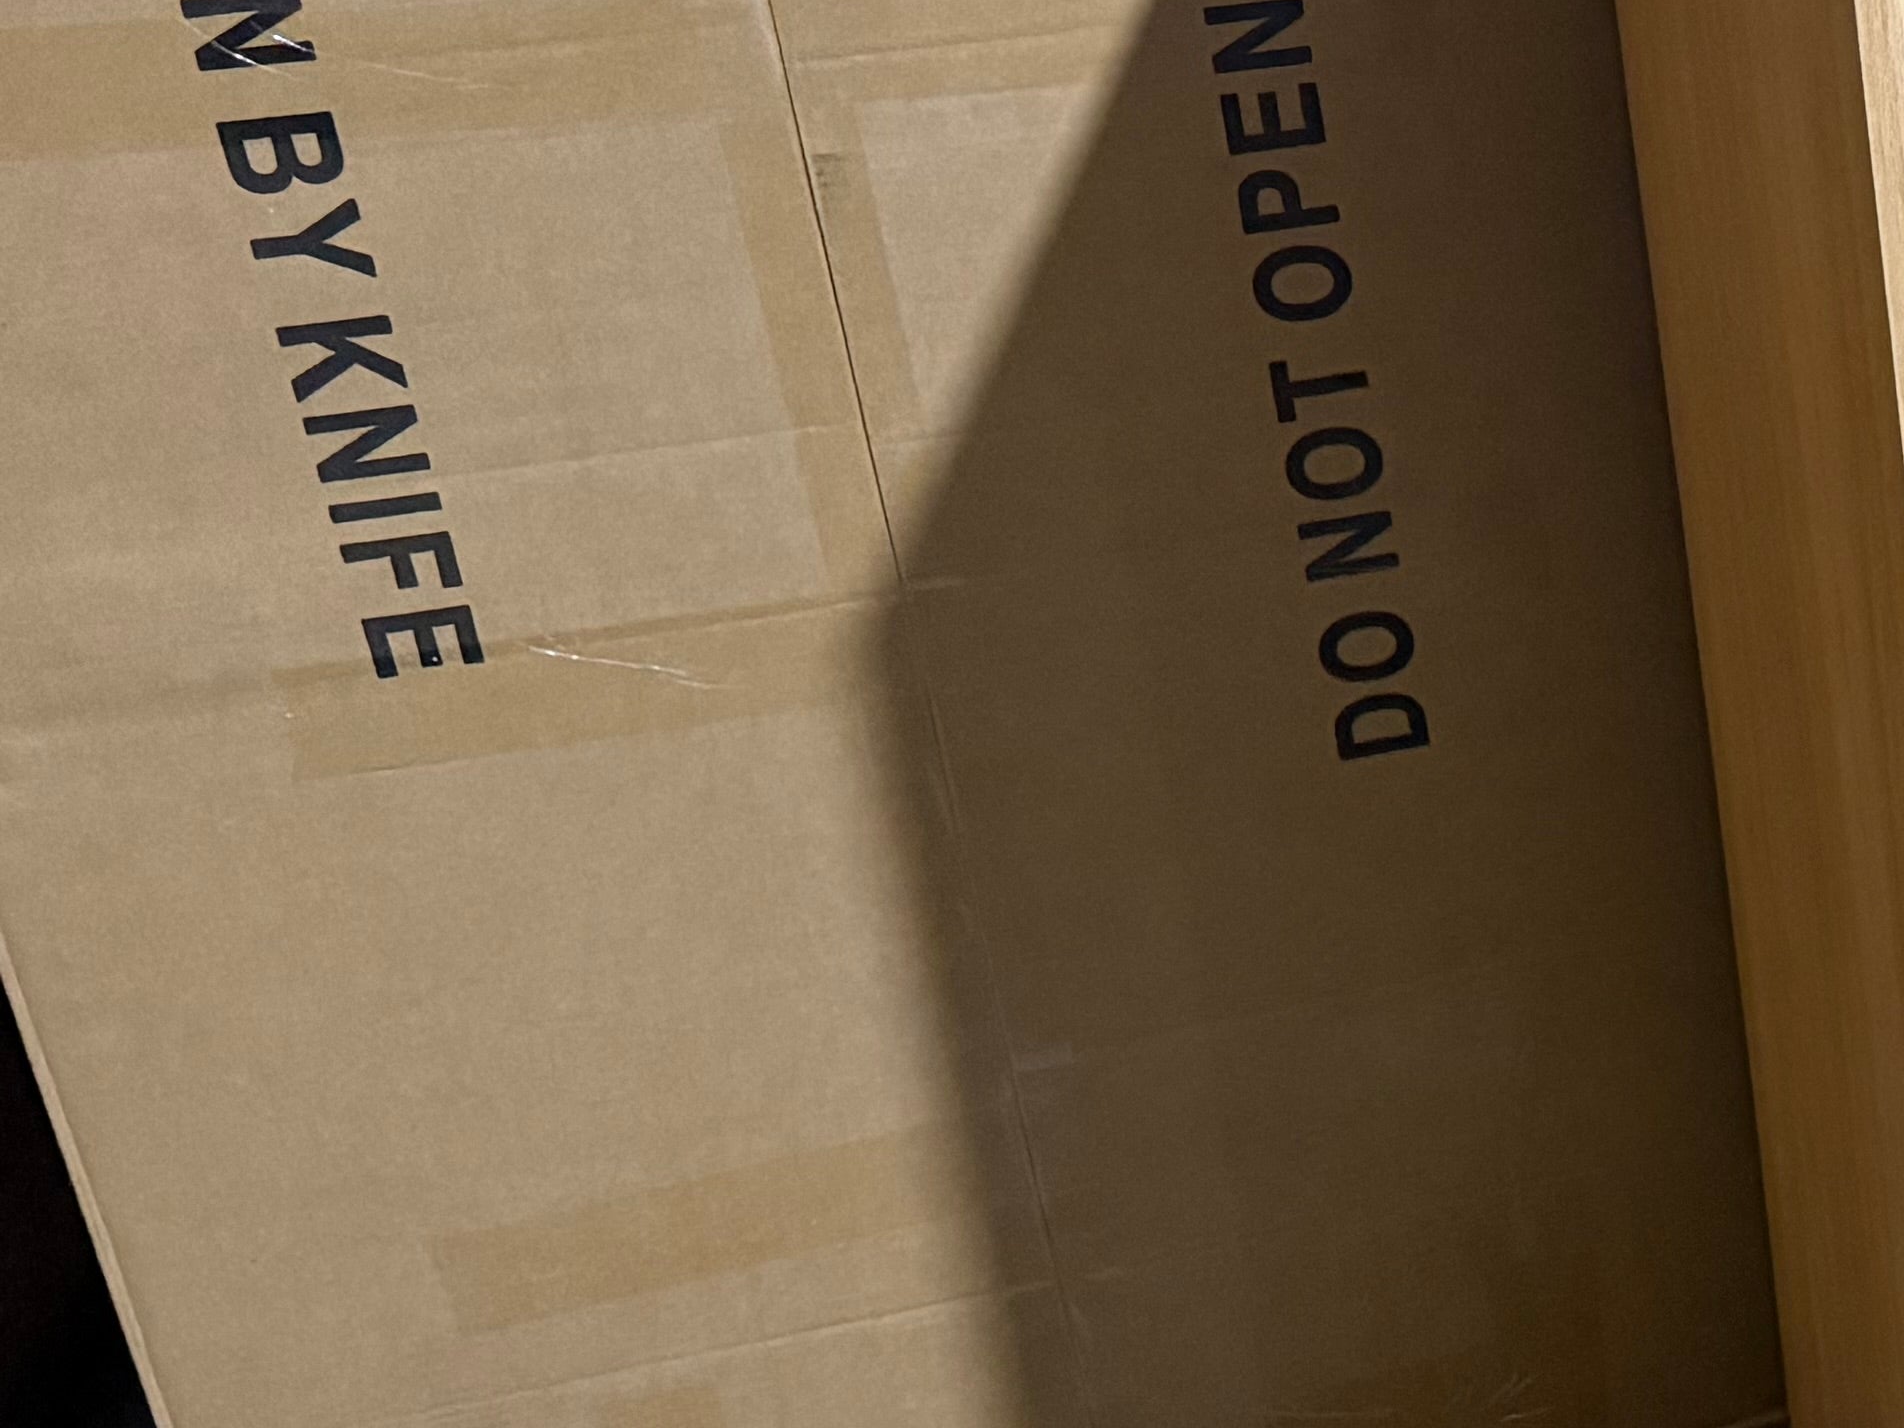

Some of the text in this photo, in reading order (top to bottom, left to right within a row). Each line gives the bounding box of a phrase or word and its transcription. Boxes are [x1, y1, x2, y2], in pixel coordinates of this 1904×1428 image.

[216, 111, 377, 278] BY
[276, 315, 485, 679] KNIFE
[1268, 360, 1400, 583] NOT
[1318, 610, 1430, 761] DO
